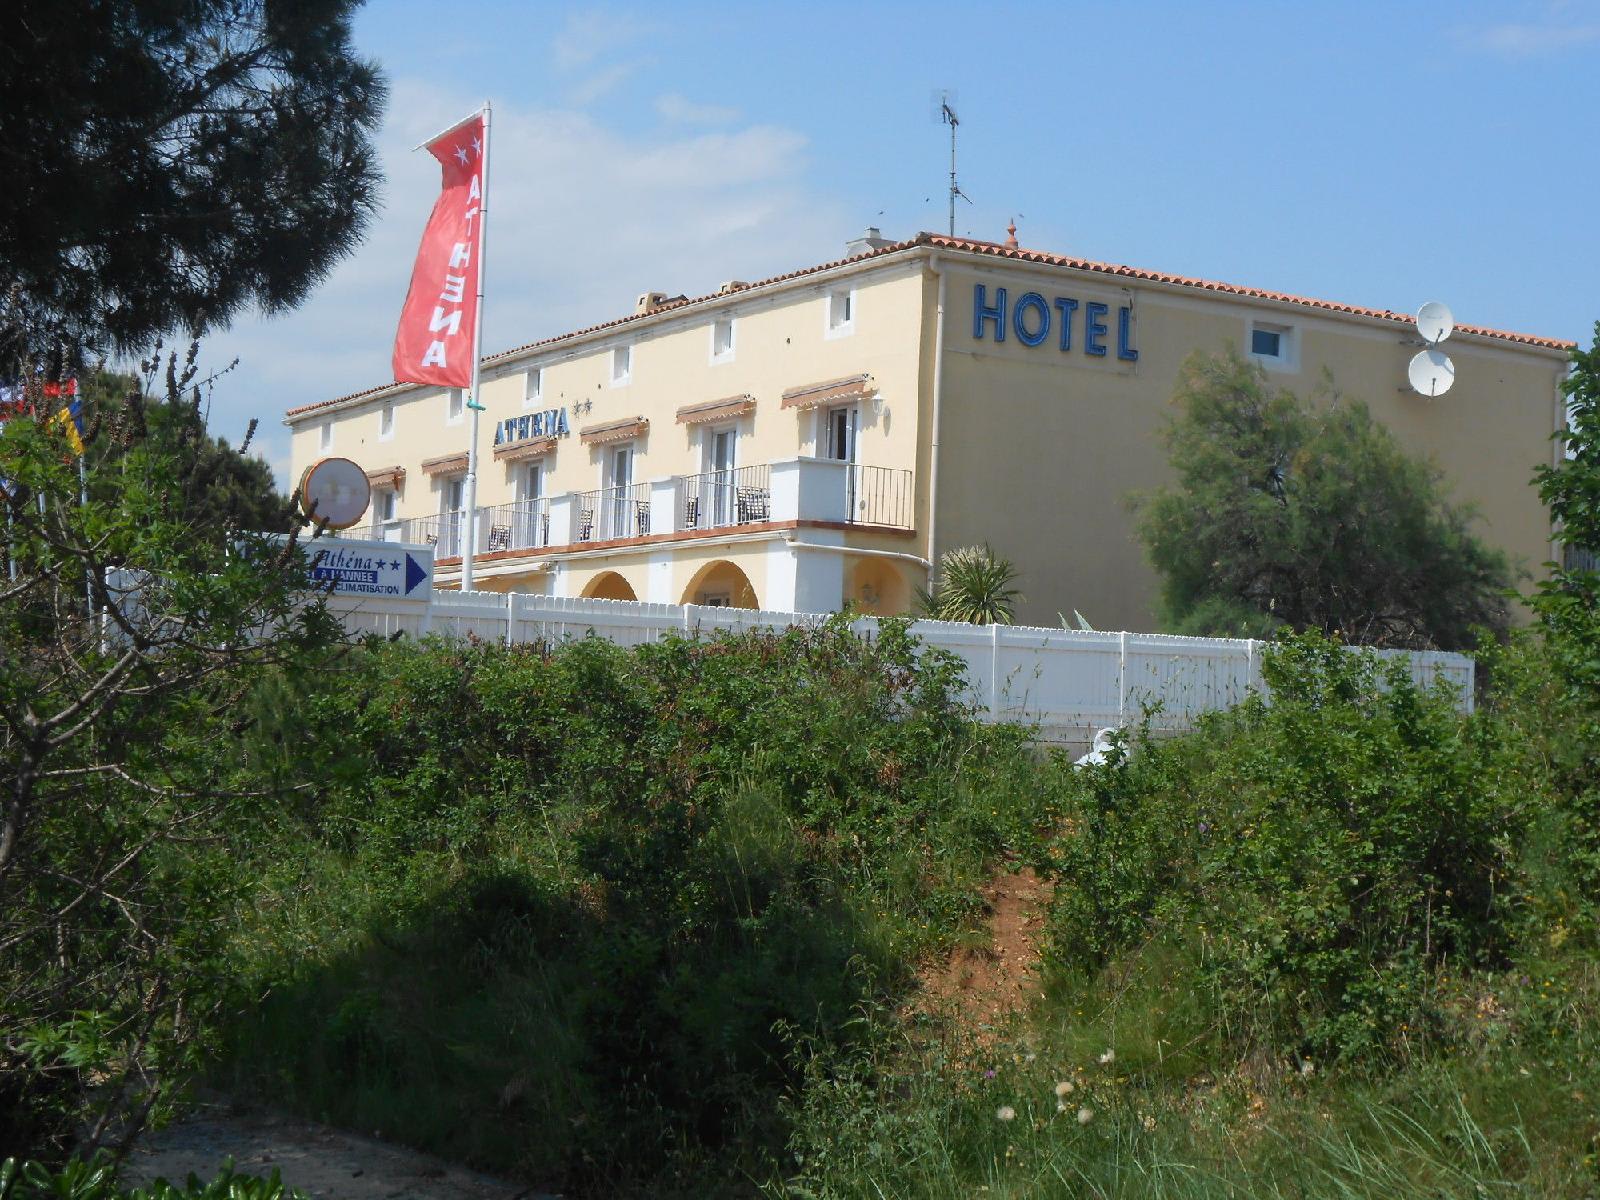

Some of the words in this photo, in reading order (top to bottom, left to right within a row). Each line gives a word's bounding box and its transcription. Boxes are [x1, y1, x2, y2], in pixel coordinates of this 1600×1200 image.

[973, 283, 1139, 361] HOTEL
[493, 407, 570, 446] ATHENA
[335, 581, 399, 595] CLIMATISATION
